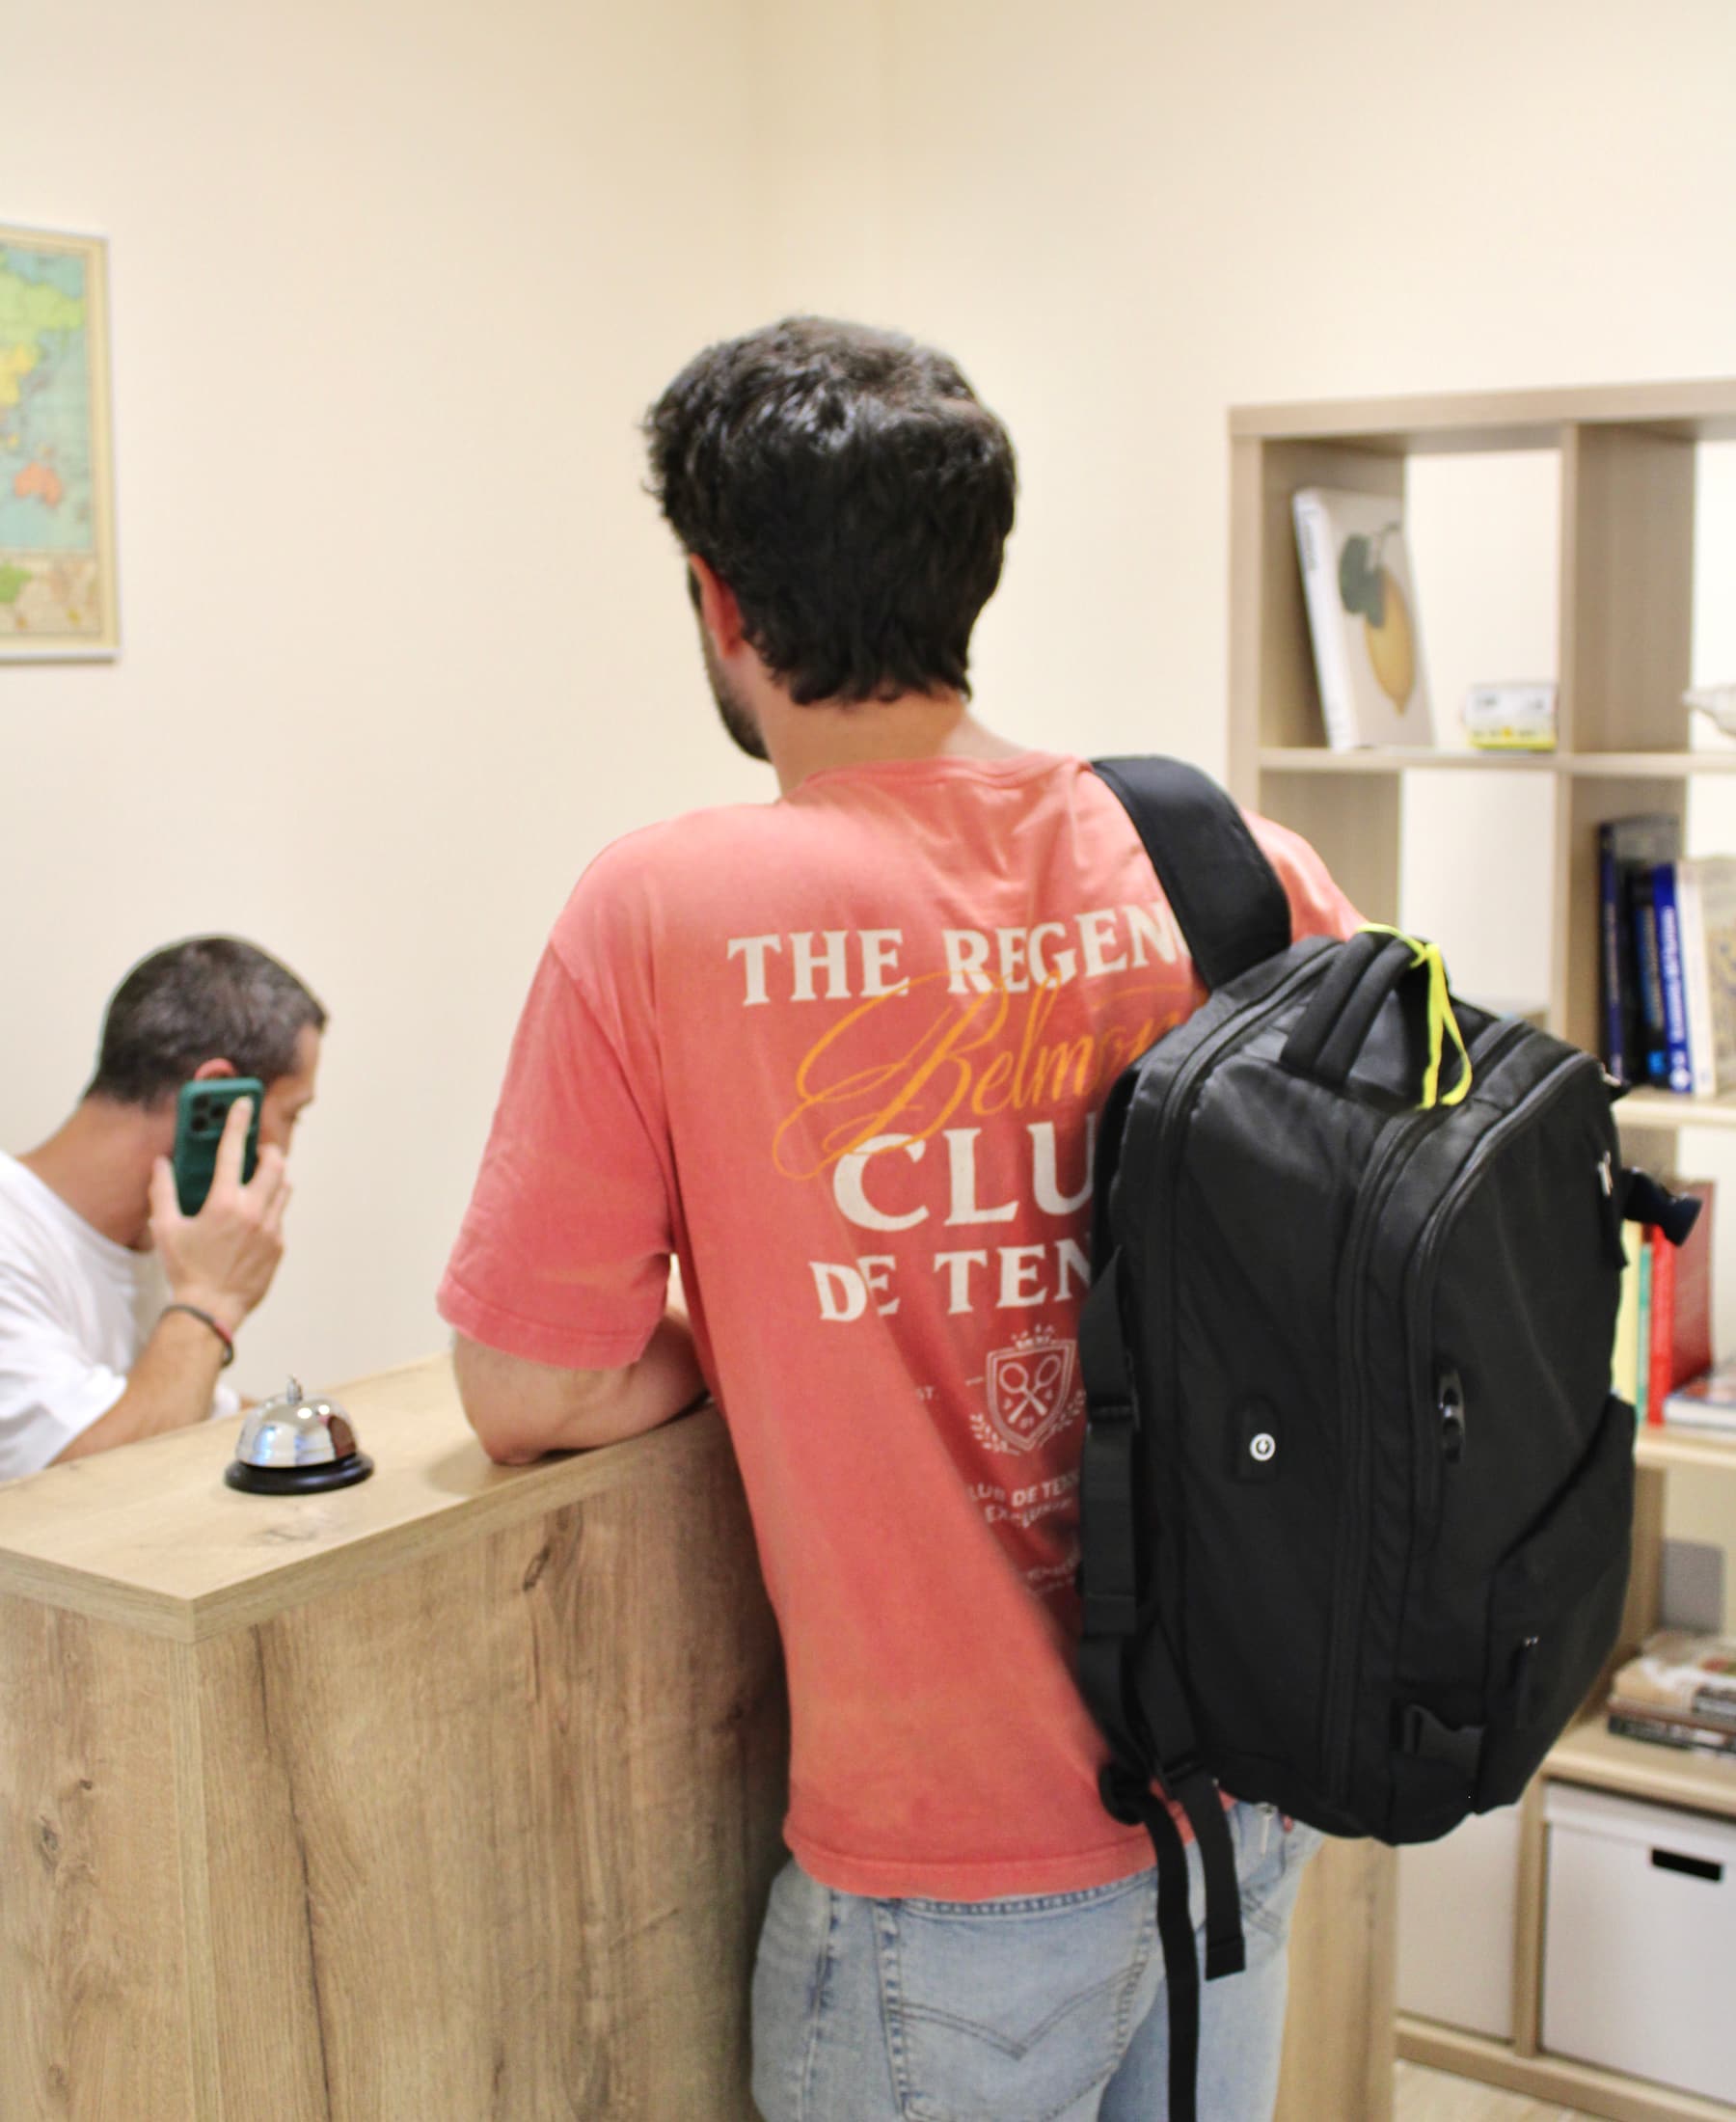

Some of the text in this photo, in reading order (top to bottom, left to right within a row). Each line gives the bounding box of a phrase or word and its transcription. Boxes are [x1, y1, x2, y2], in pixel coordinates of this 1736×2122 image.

[727, 901, 1192, 1007] THE REGEN
[808, 1256, 901, 1321] DE
